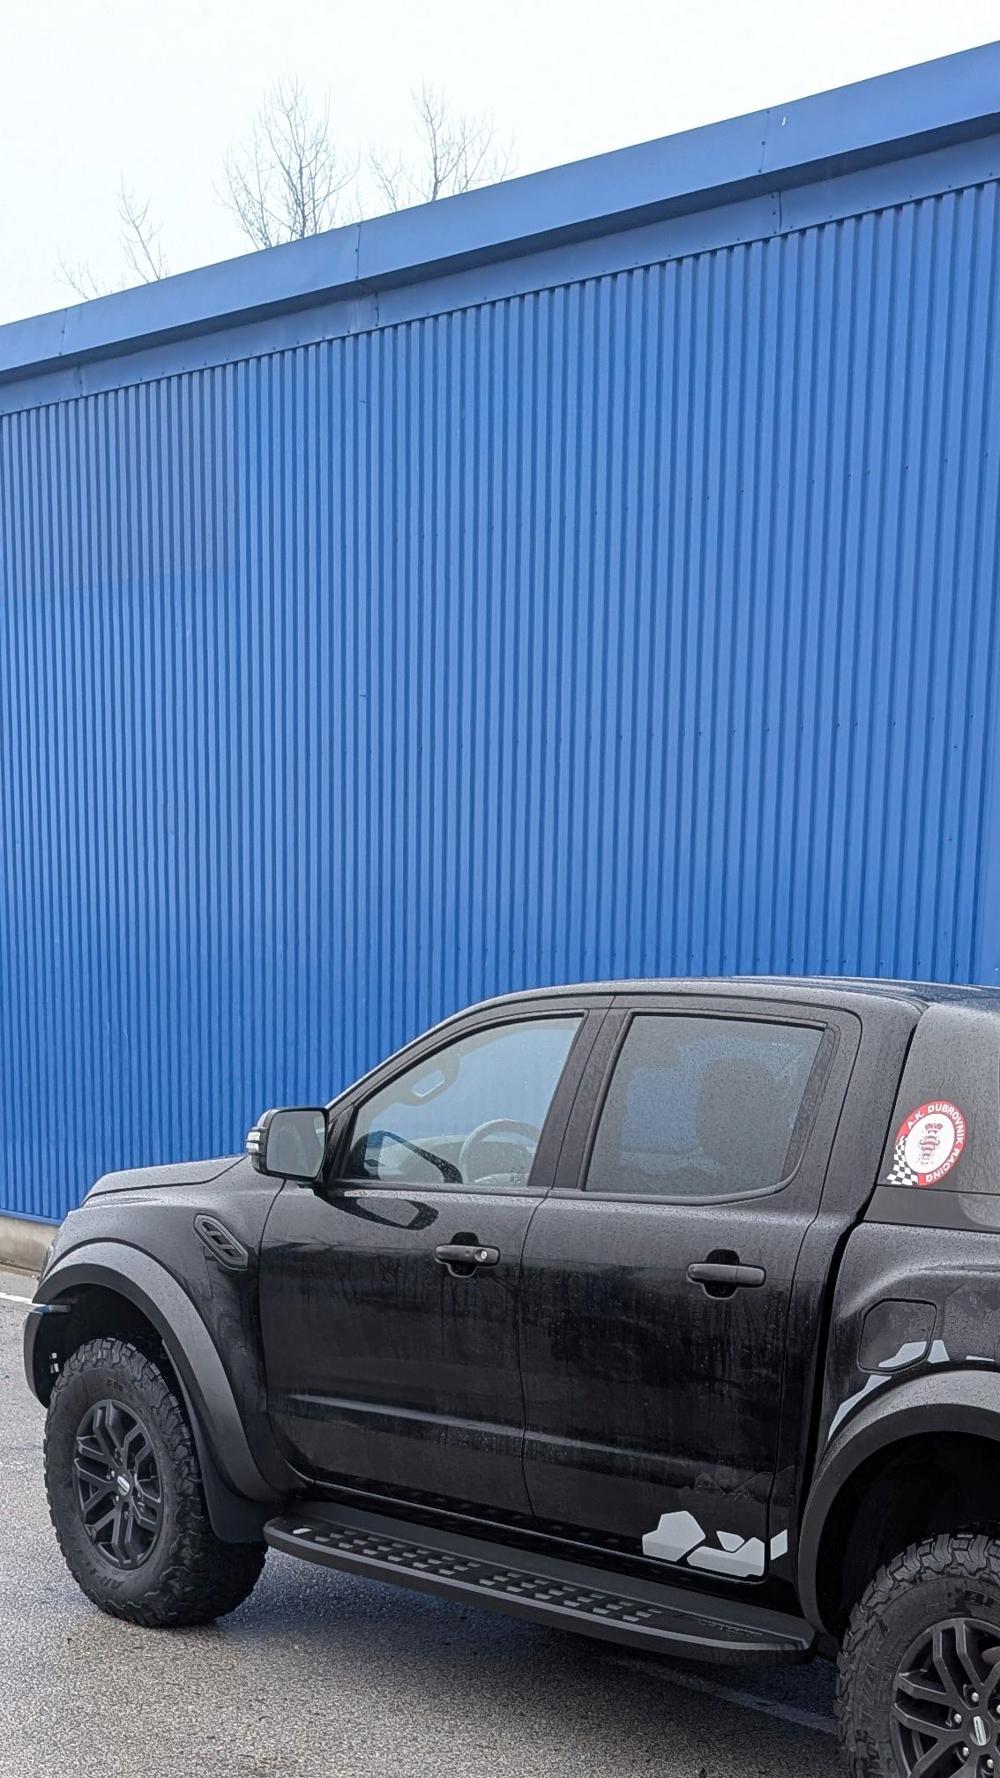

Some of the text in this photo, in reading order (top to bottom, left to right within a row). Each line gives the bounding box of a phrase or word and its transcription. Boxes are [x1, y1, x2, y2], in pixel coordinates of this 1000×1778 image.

[908, 1103, 965, 1182] A.K. DUBROVNIK RACING
